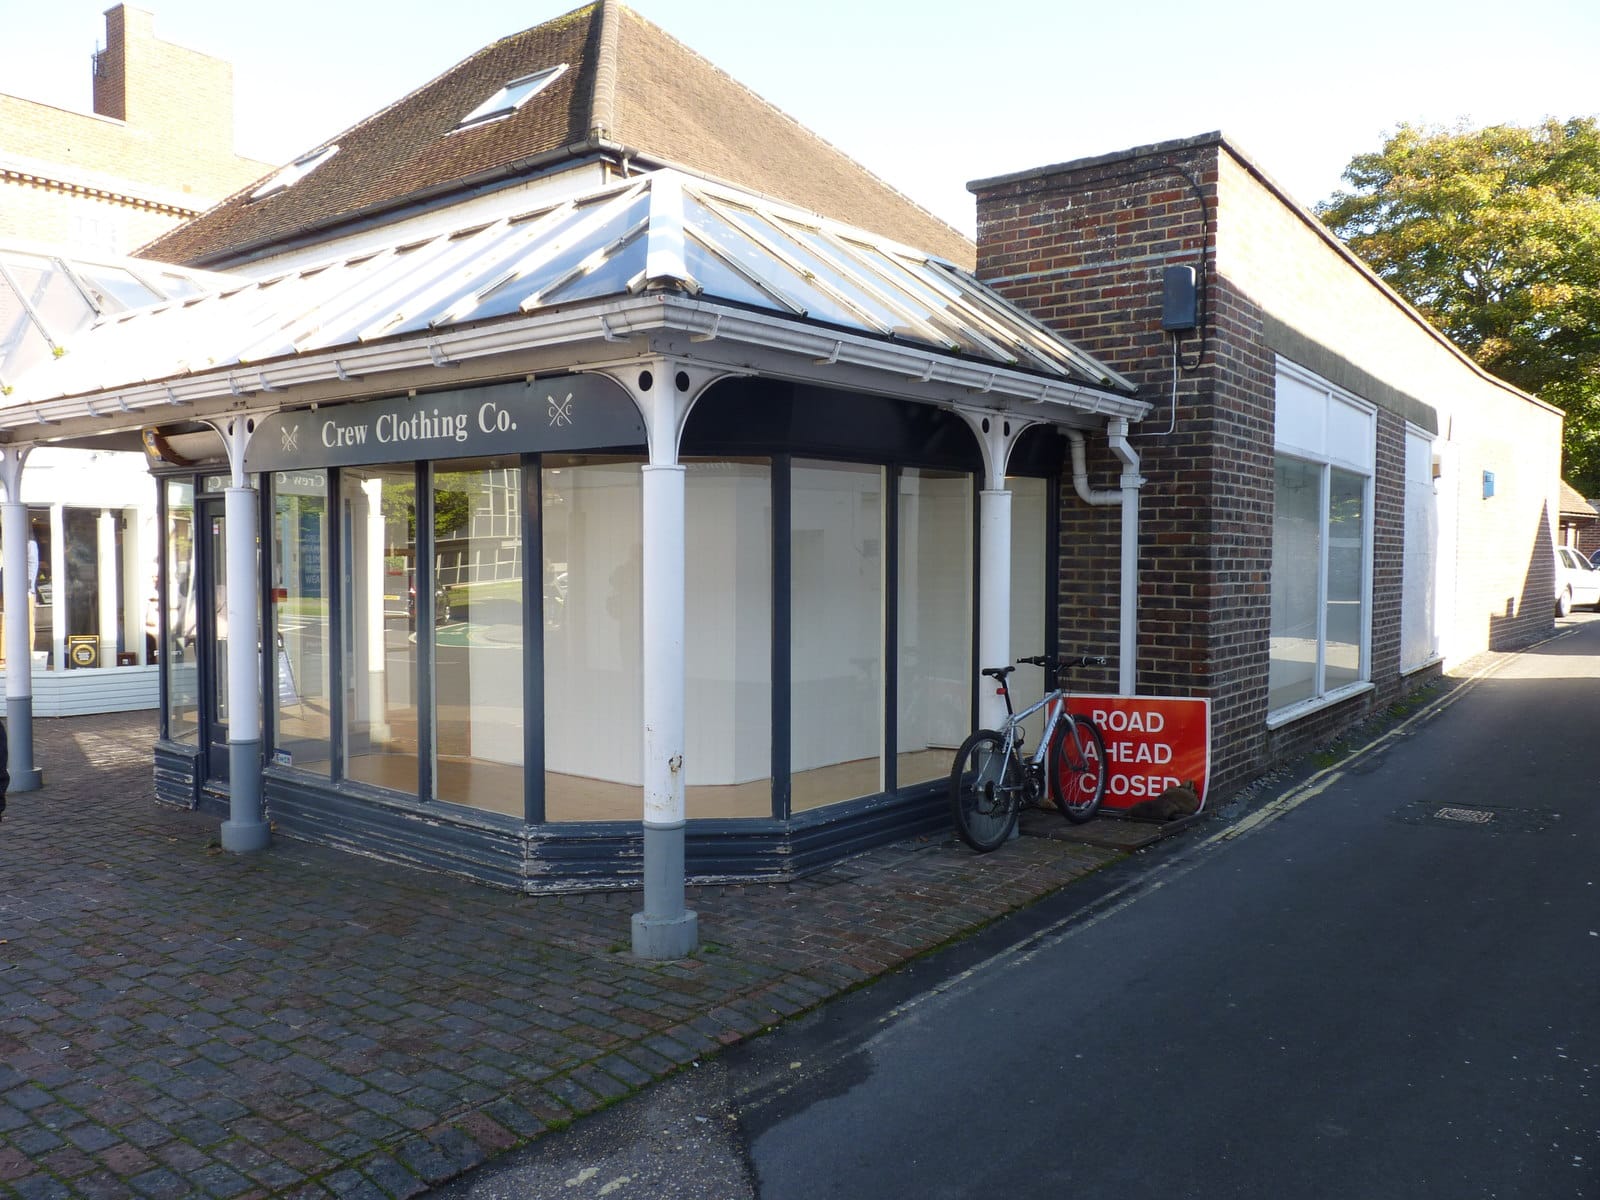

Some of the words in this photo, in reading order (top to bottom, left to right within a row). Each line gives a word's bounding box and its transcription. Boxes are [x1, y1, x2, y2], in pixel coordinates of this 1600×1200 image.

[321, 420, 368, 448] Crew
[376, 408, 468, 442] Clothing
[478, 402, 517, 433] Co.
[1092, 709, 1165, 733] ROAD
[1083, 740, 1173, 765] AHEAD
[1079, 772, 1181, 797] COSED
